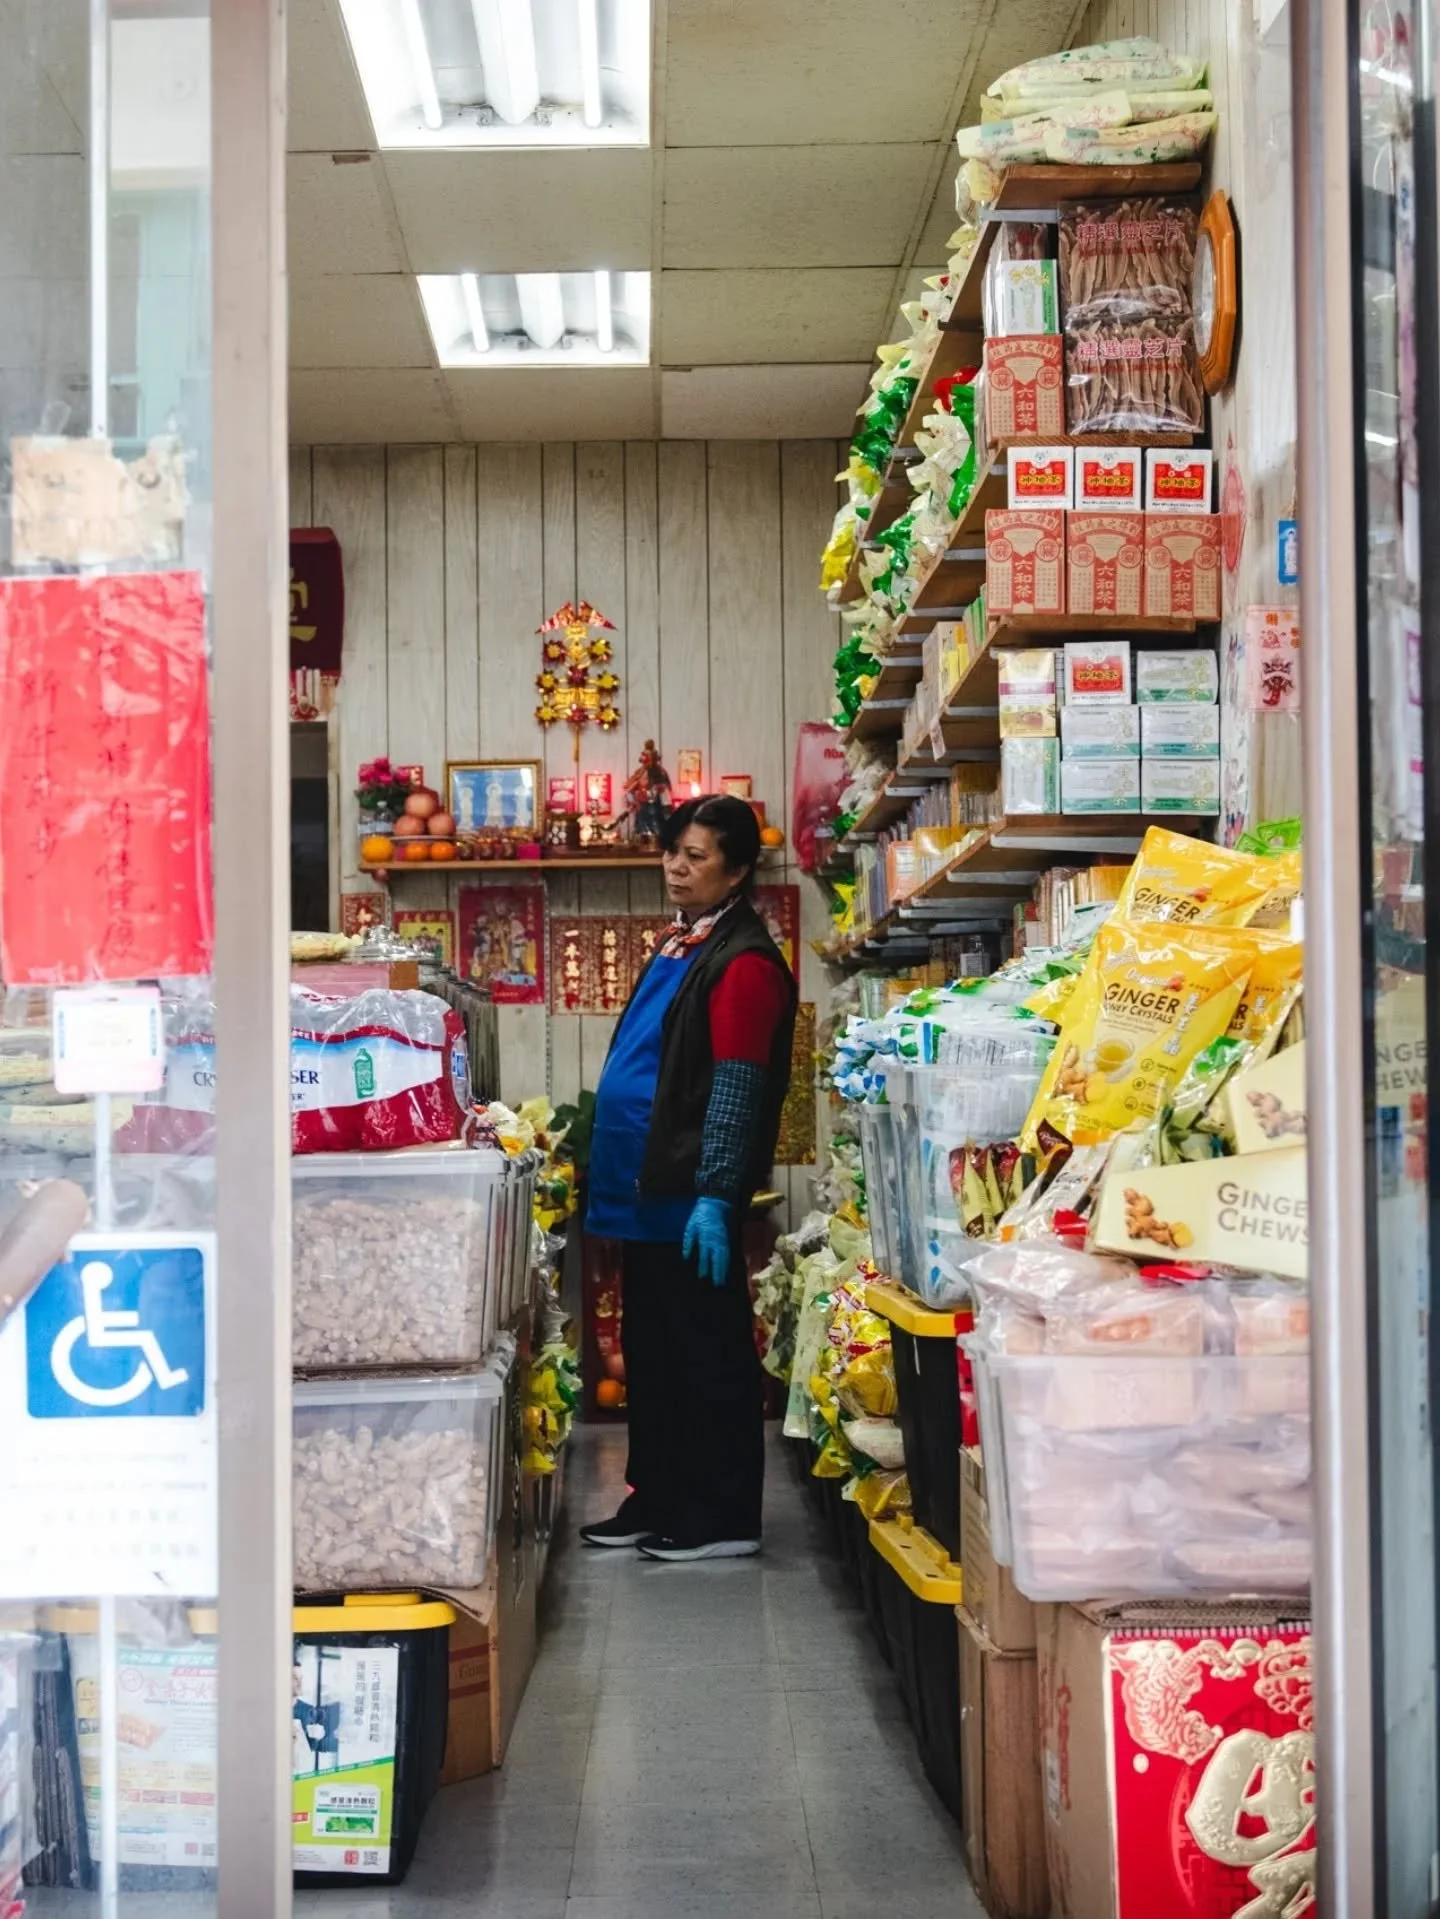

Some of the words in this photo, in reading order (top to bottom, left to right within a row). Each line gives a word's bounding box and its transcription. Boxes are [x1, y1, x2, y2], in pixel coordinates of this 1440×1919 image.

[1016, 388, 1035, 426] 六和茶
[1015, 560, 1033, 598] 六和茶
[1096, 565, 1114, 604] 六和茶
[1173, 568, 1191, 606] 六和茶
[1105, 983, 1180, 1015] GINGER
